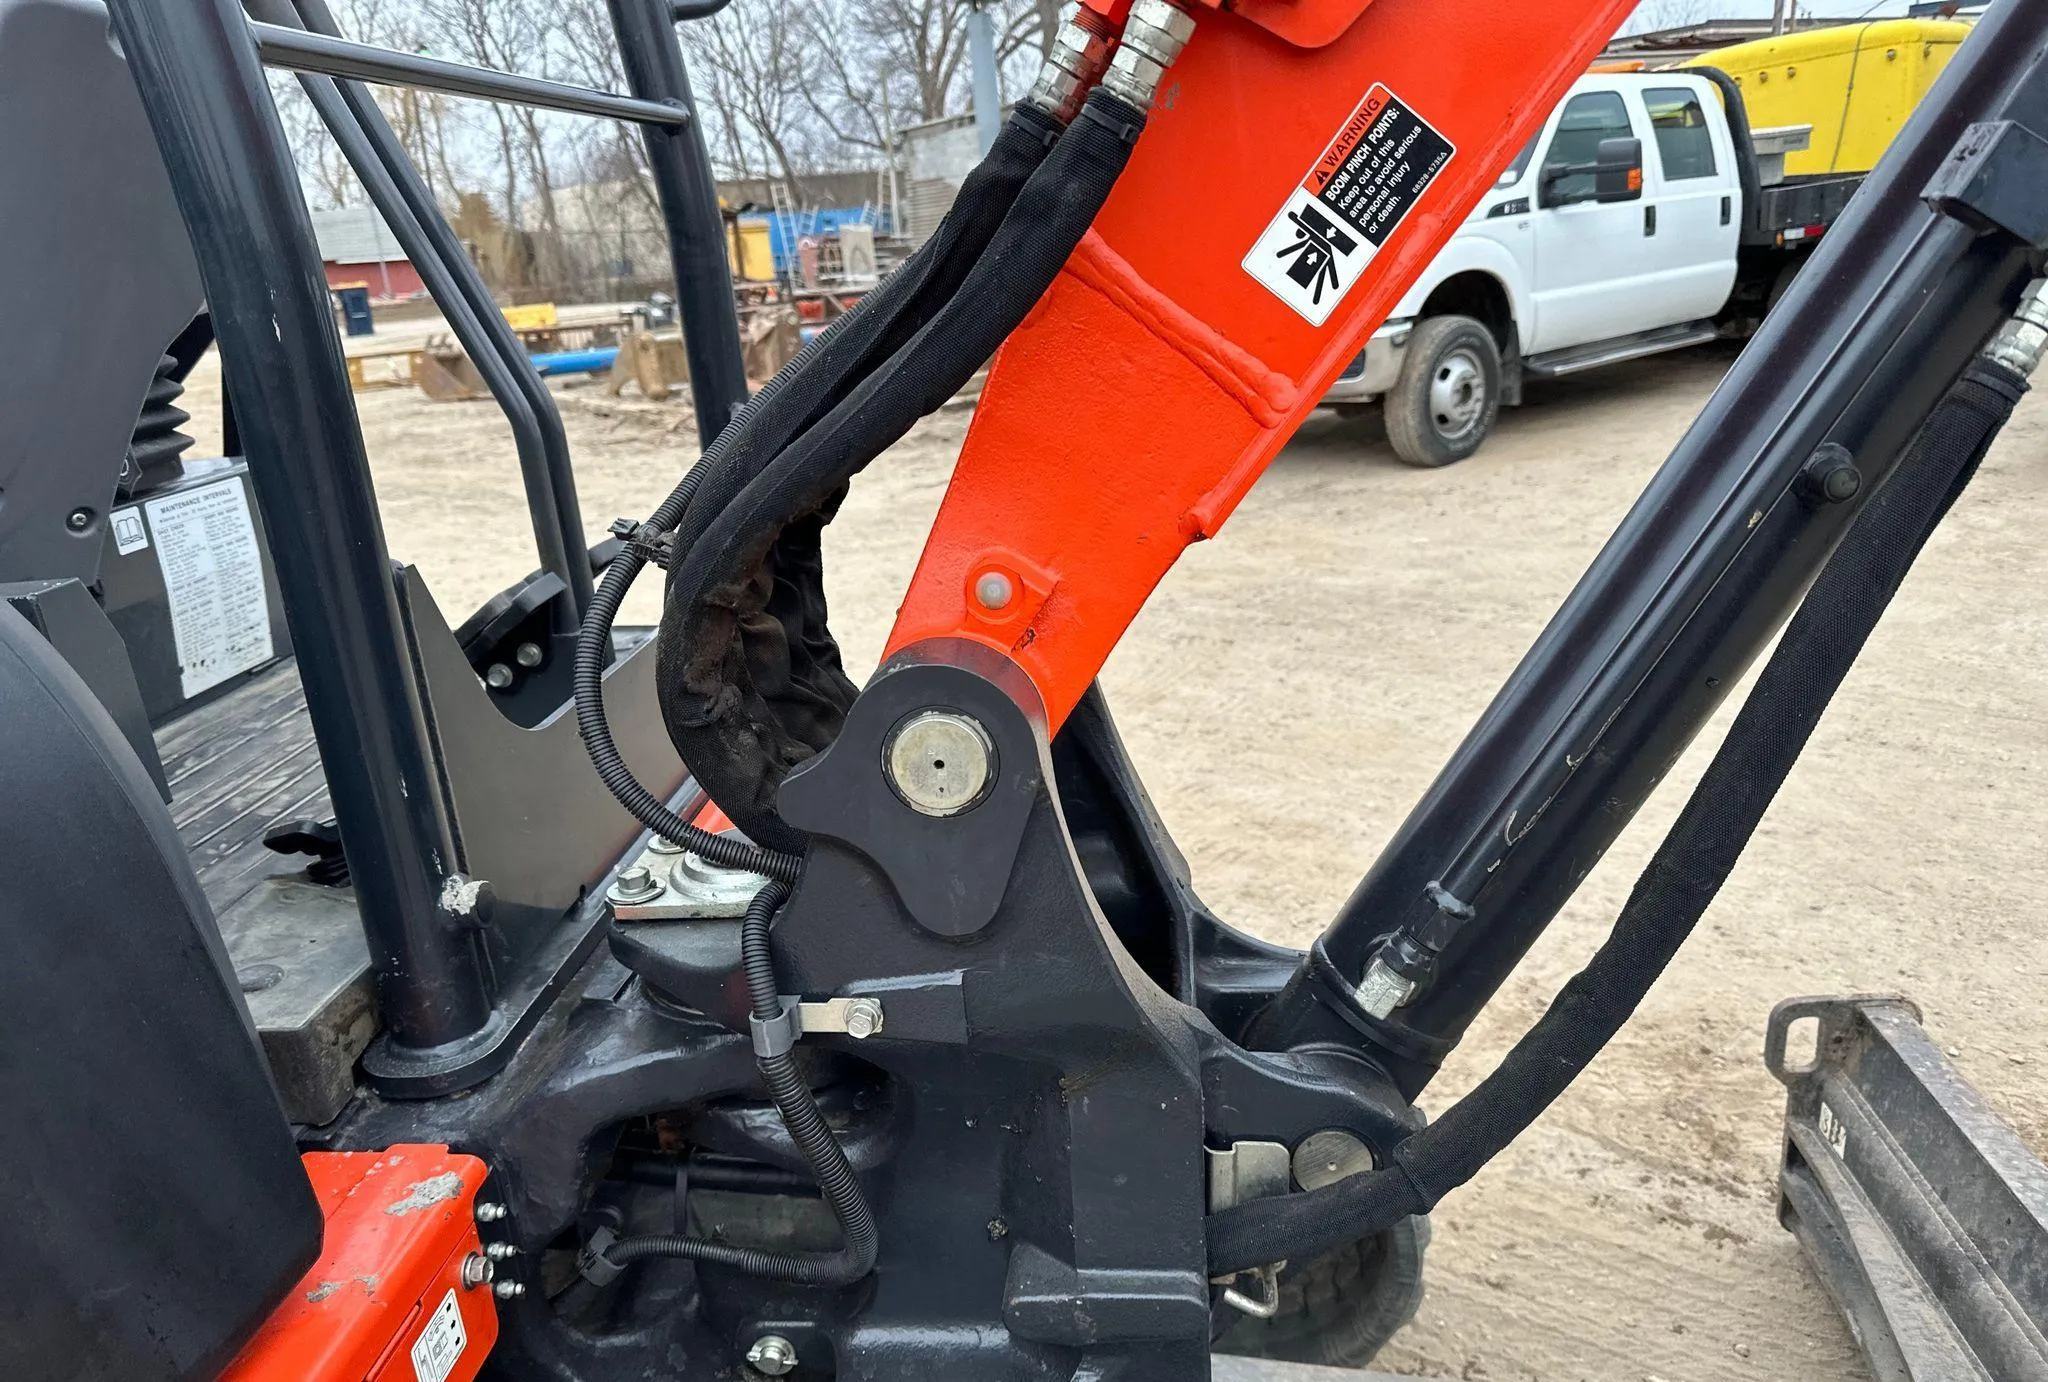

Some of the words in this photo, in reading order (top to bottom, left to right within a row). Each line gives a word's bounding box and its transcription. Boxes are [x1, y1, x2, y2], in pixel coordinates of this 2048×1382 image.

[1324, 98, 1381, 167] WARNING
[1325, 171, 1351, 201] BOOM
[1345, 143, 1372, 174] PINCH
[1367, 108, 1400, 144] POINTS:
[1337, 185, 1360, 210] Keep
[1358, 168, 1374, 185] out
[1371, 155, 1381, 168] of
[1378, 139, 1396, 157] this
[1349, 196, 1368, 218] area
[1364, 185, 1376, 196] to
[1374, 158, 1396, 185] avoid
[1394, 125, 1422, 160] serious
[1358, 186, 1390, 228] personal
[1387, 160, 1411, 188] injury
[1368, 222, 1379, 234] or
[1377, 195, 1402, 222] death.
[160, 497, 200, 514] MAINTENANCE
[202, 488, 232, 501] INTERVALS
